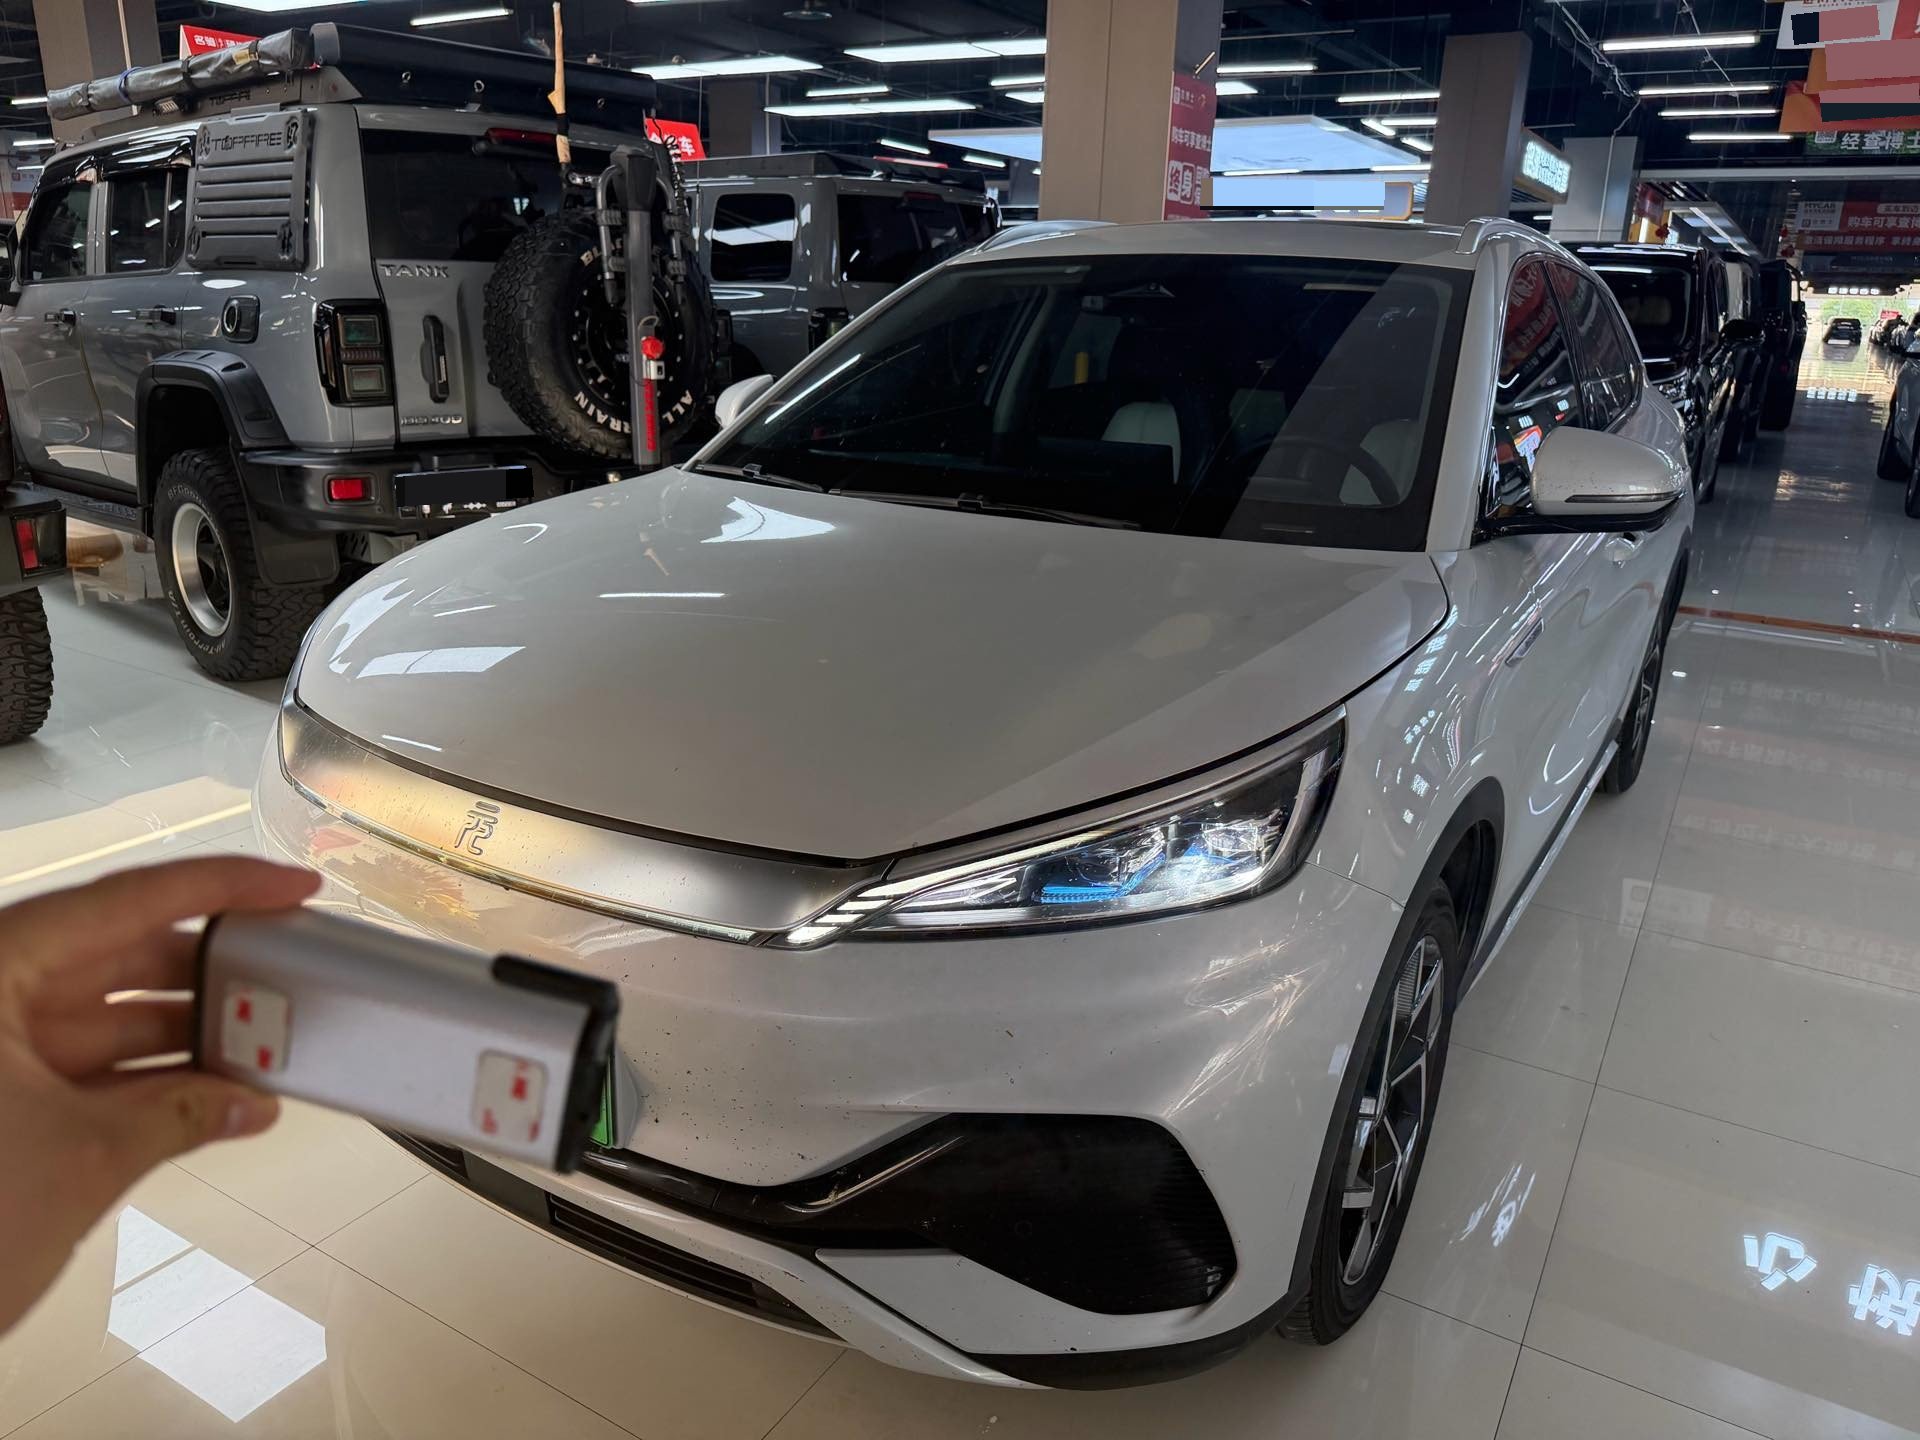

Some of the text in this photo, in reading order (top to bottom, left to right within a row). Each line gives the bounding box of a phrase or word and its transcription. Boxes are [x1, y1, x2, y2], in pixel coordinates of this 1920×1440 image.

[379, 264, 449, 279] TANK
[574, 391, 632, 435] RRAIN
[661, 388, 694, 425] ALL
